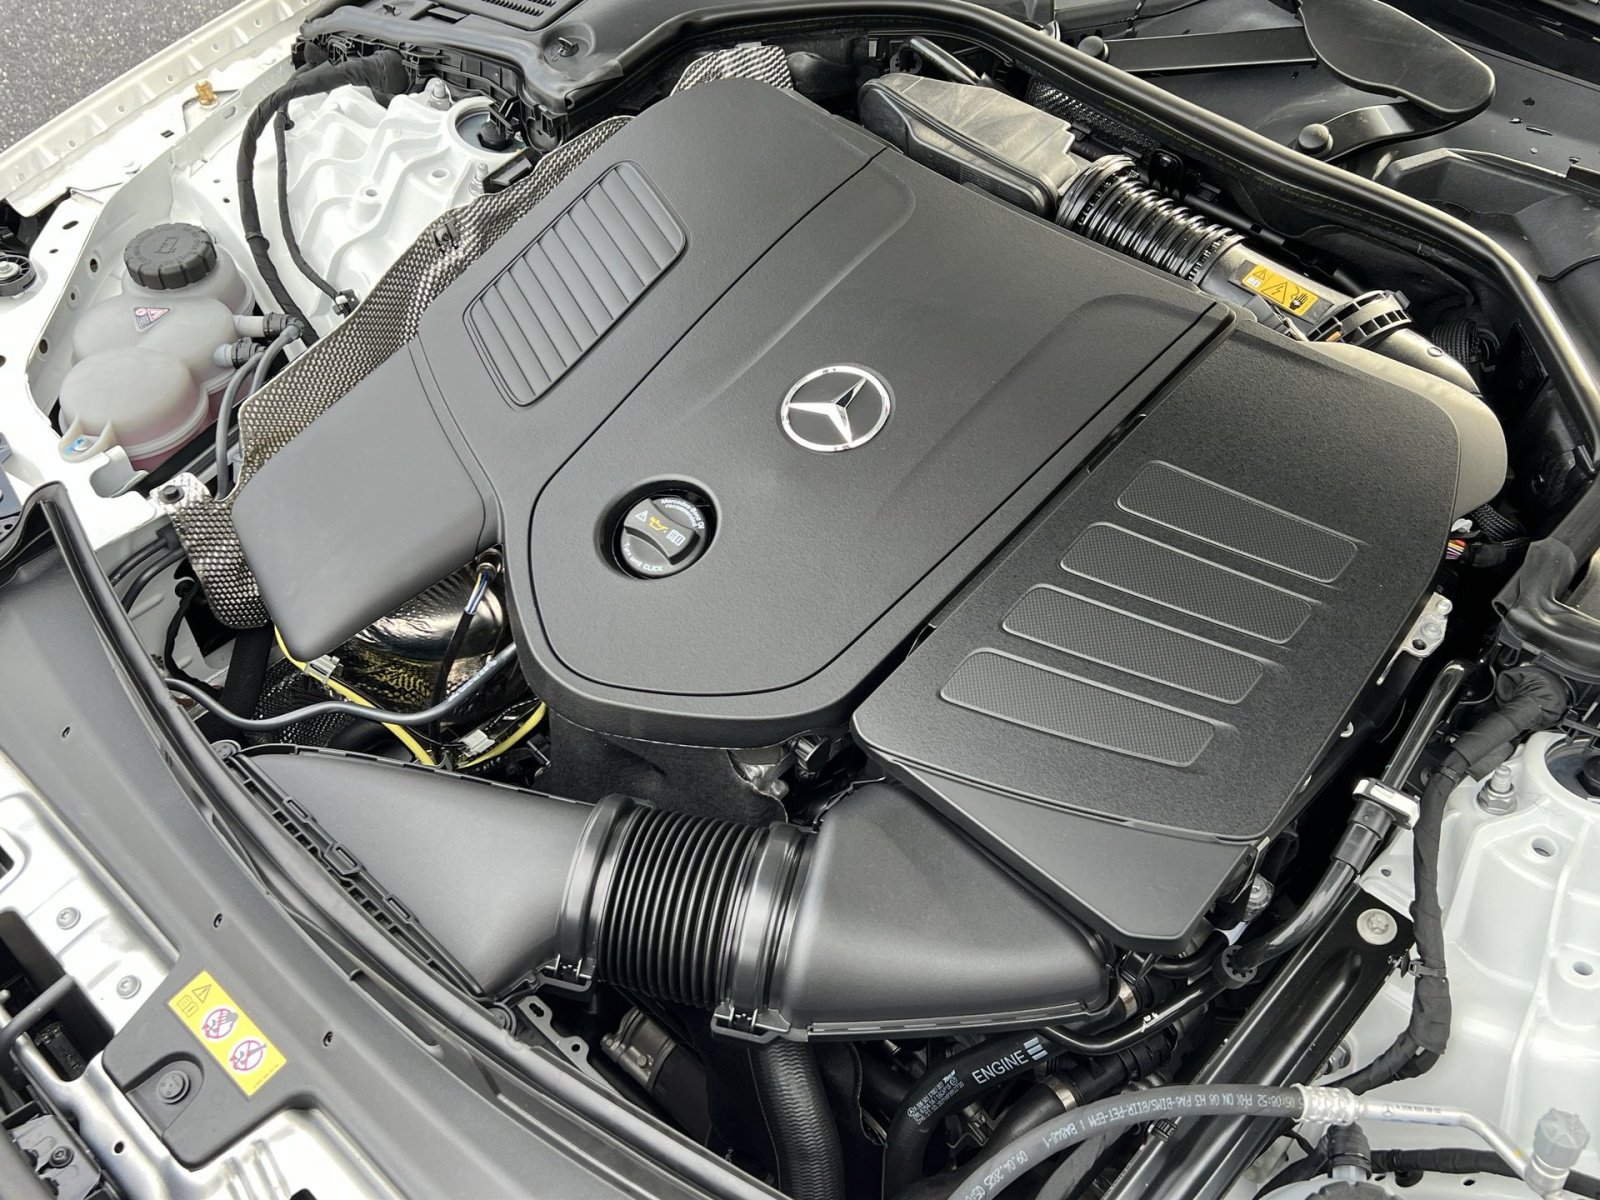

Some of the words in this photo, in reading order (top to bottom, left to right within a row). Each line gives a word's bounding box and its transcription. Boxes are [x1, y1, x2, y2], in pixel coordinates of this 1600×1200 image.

[643, 563, 664, 572] CLICK
[972, 1050, 1029, 1084] ENGINE
[1194, 1093, 1206, 1107] H3
